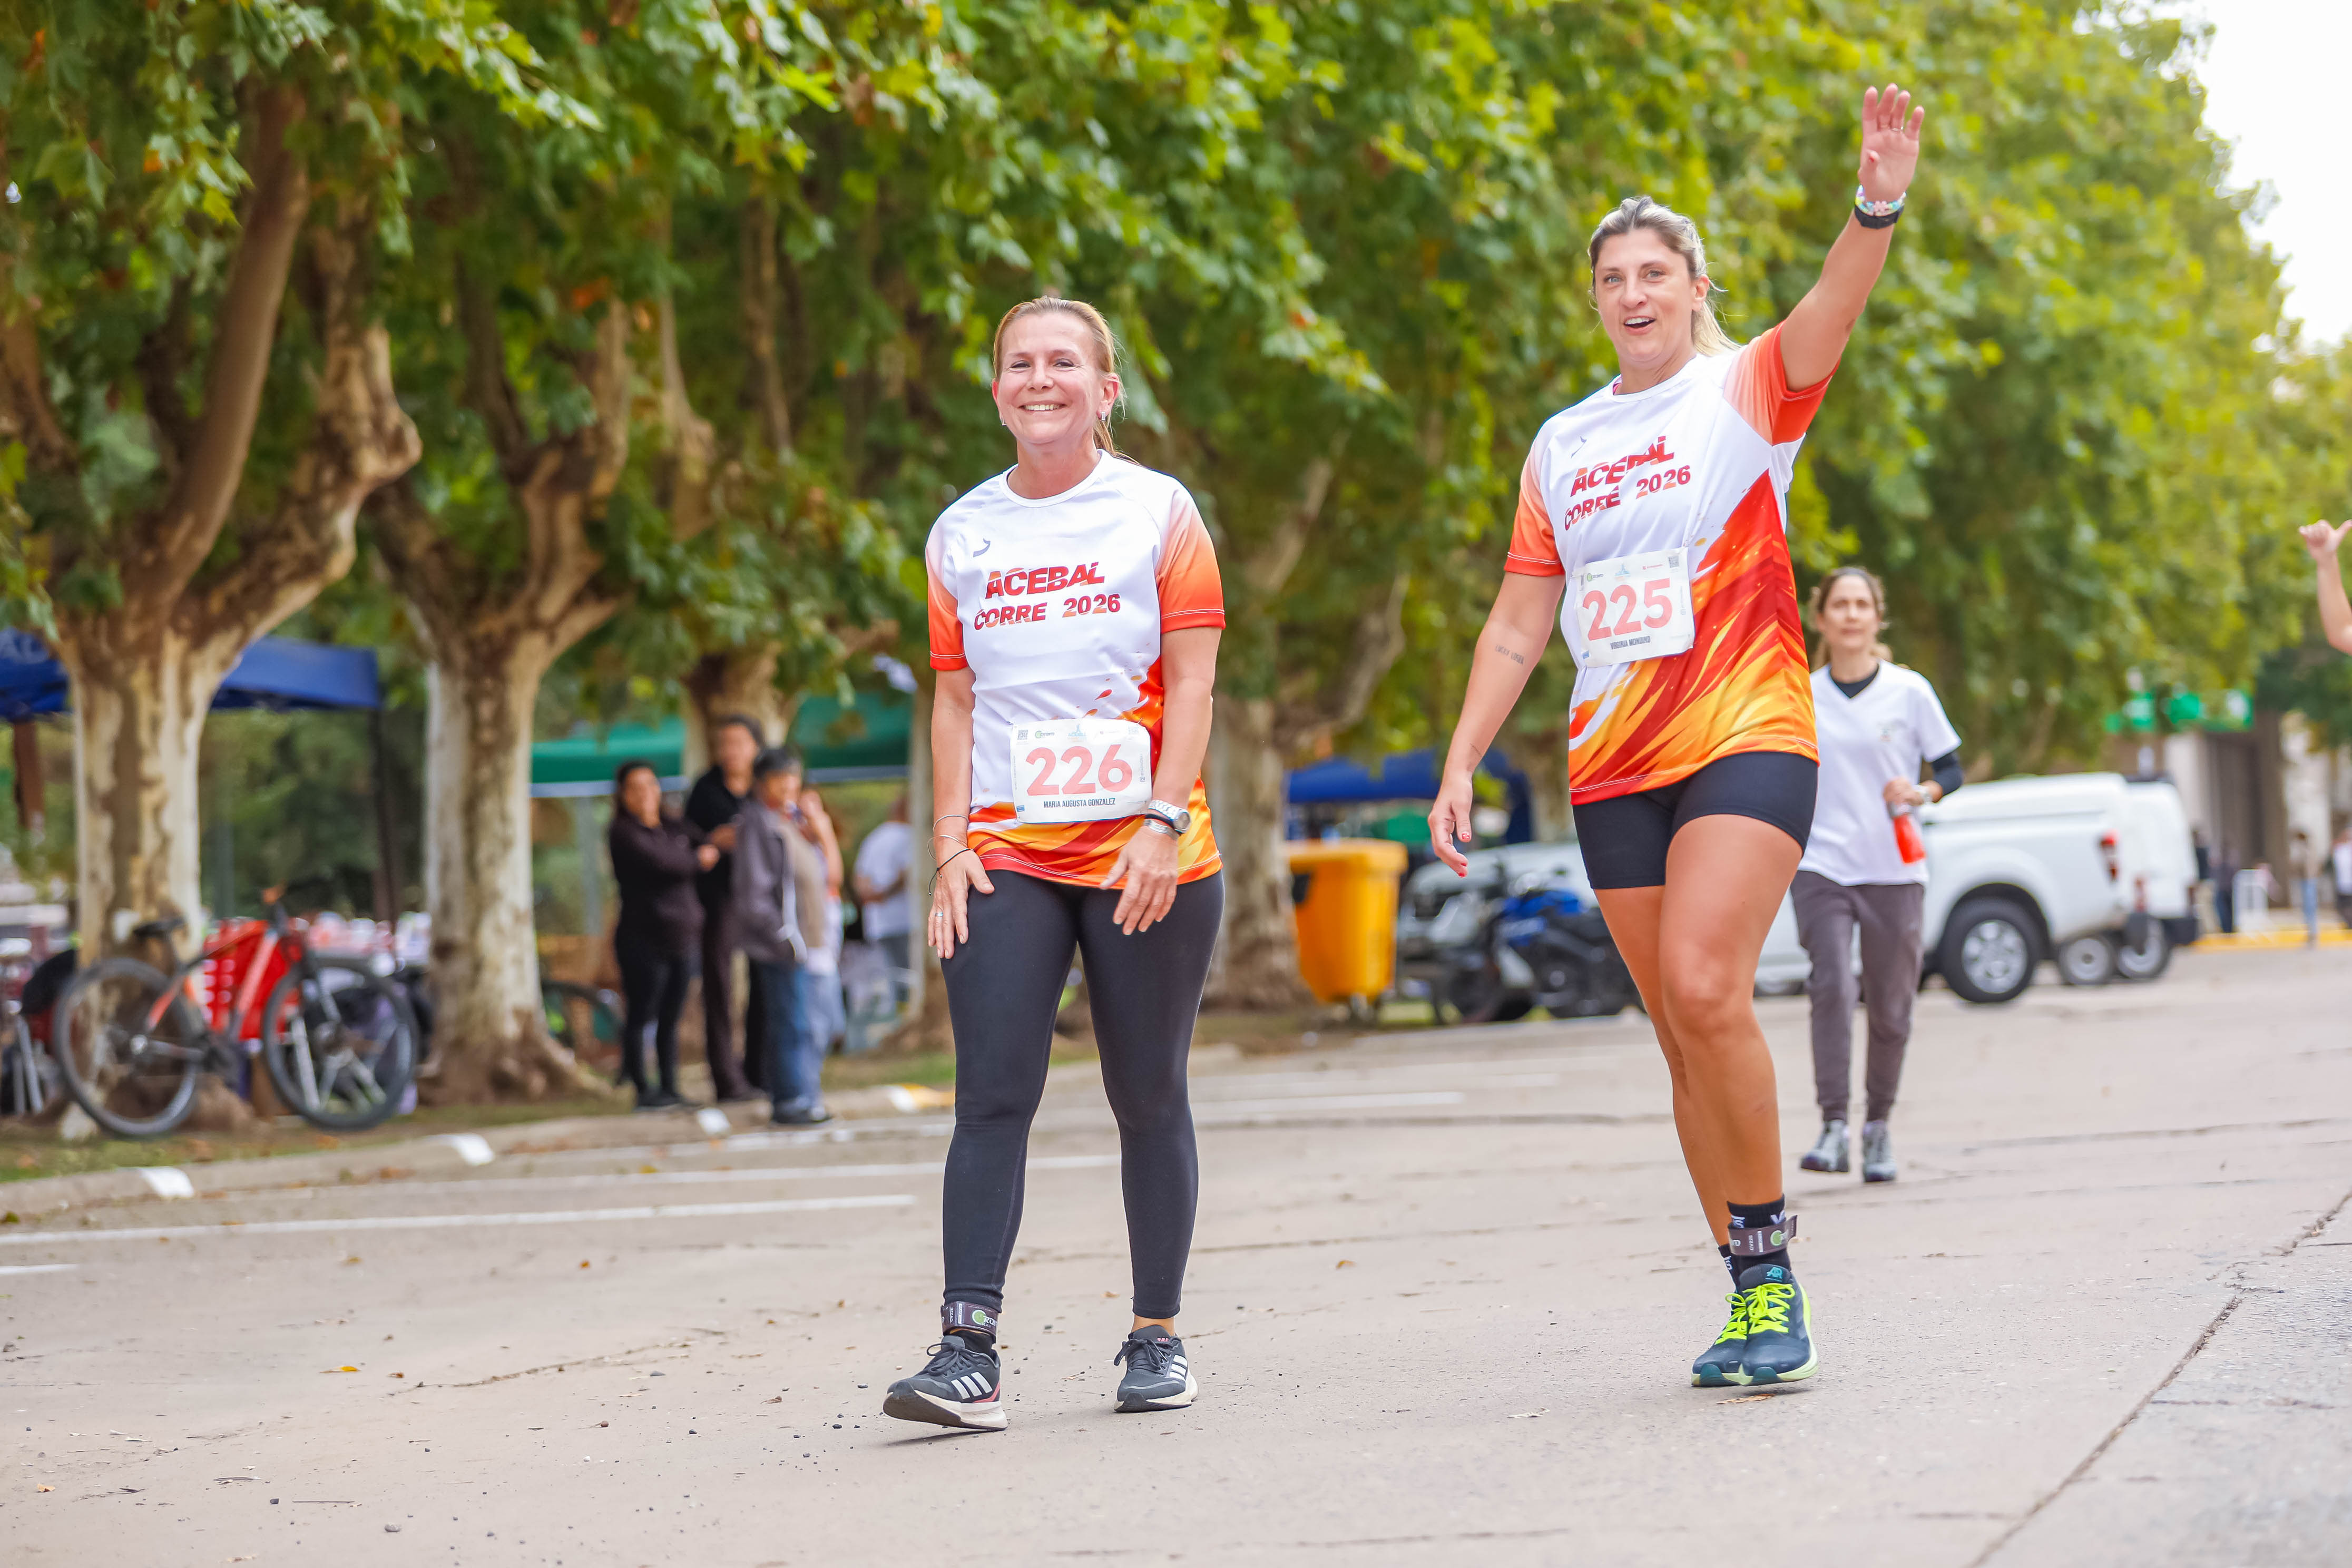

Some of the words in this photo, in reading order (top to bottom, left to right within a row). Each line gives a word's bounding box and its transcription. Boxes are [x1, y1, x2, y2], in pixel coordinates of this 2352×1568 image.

[1636, 465, 1690, 499] 2026
[985, 562, 1105, 599] ACEBAL
[974, 602, 1047, 630] CORRE
[1062, 594, 1120, 618] 2026
[1582, 579, 1672, 641] 225
[1610, 640, 1629, 650] VIRGINIA
[1026, 744, 1132, 796] 226
